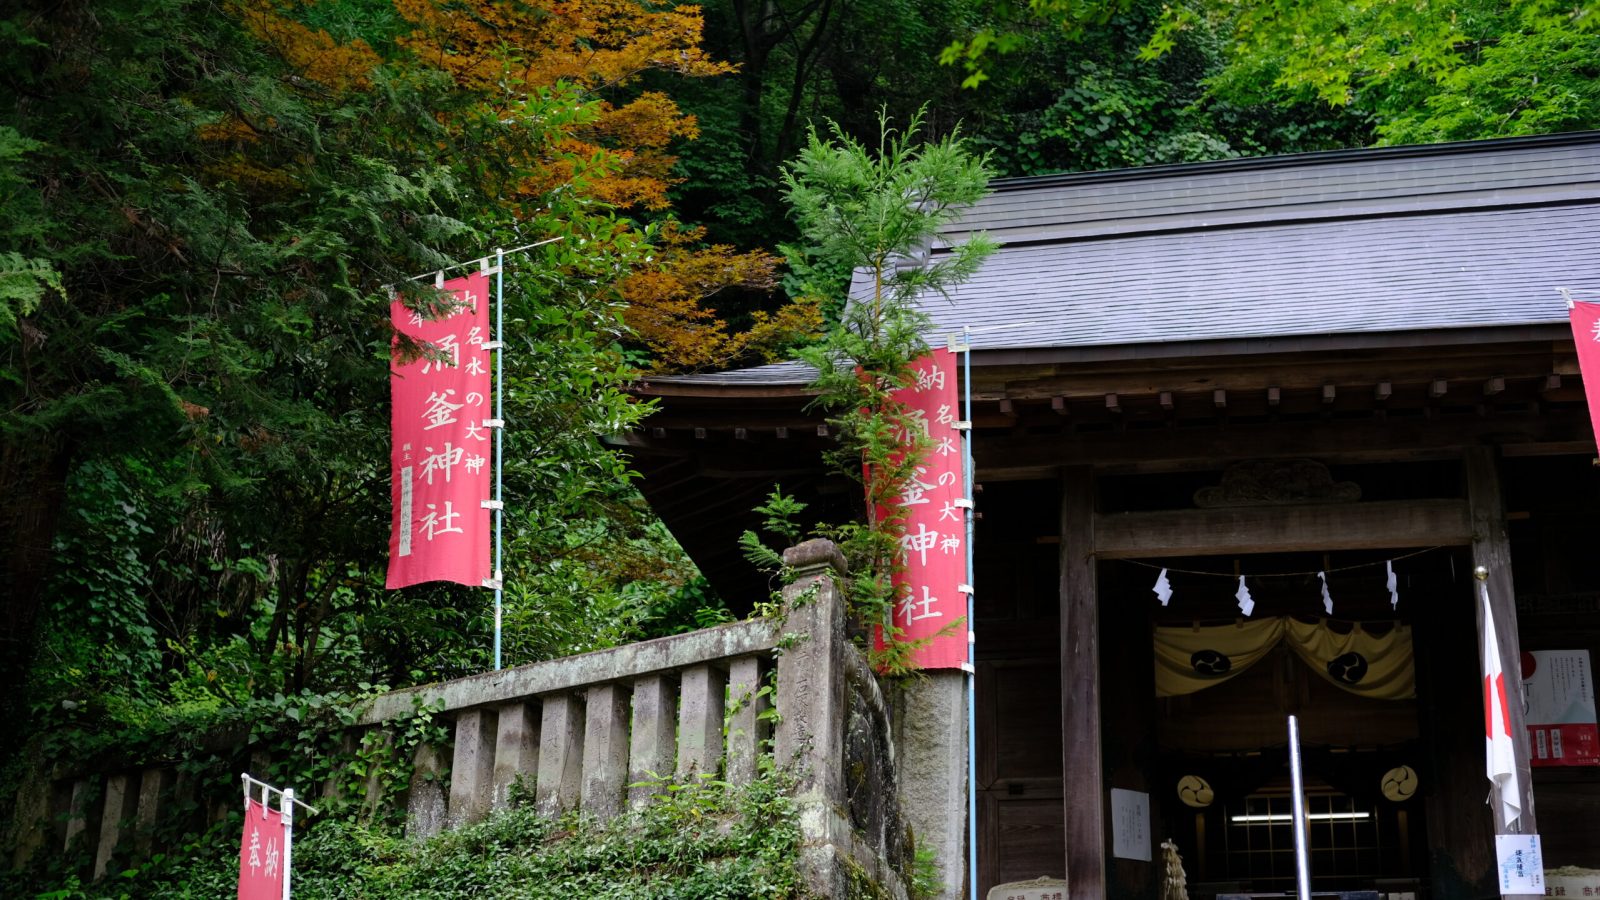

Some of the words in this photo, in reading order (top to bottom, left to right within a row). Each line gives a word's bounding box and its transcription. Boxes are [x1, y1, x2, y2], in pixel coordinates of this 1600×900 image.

[464, 326, 487, 475] 名水の大神
[935, 403, 960, 557] 名水の大神
[248, 825, 279, 880] 奉納
